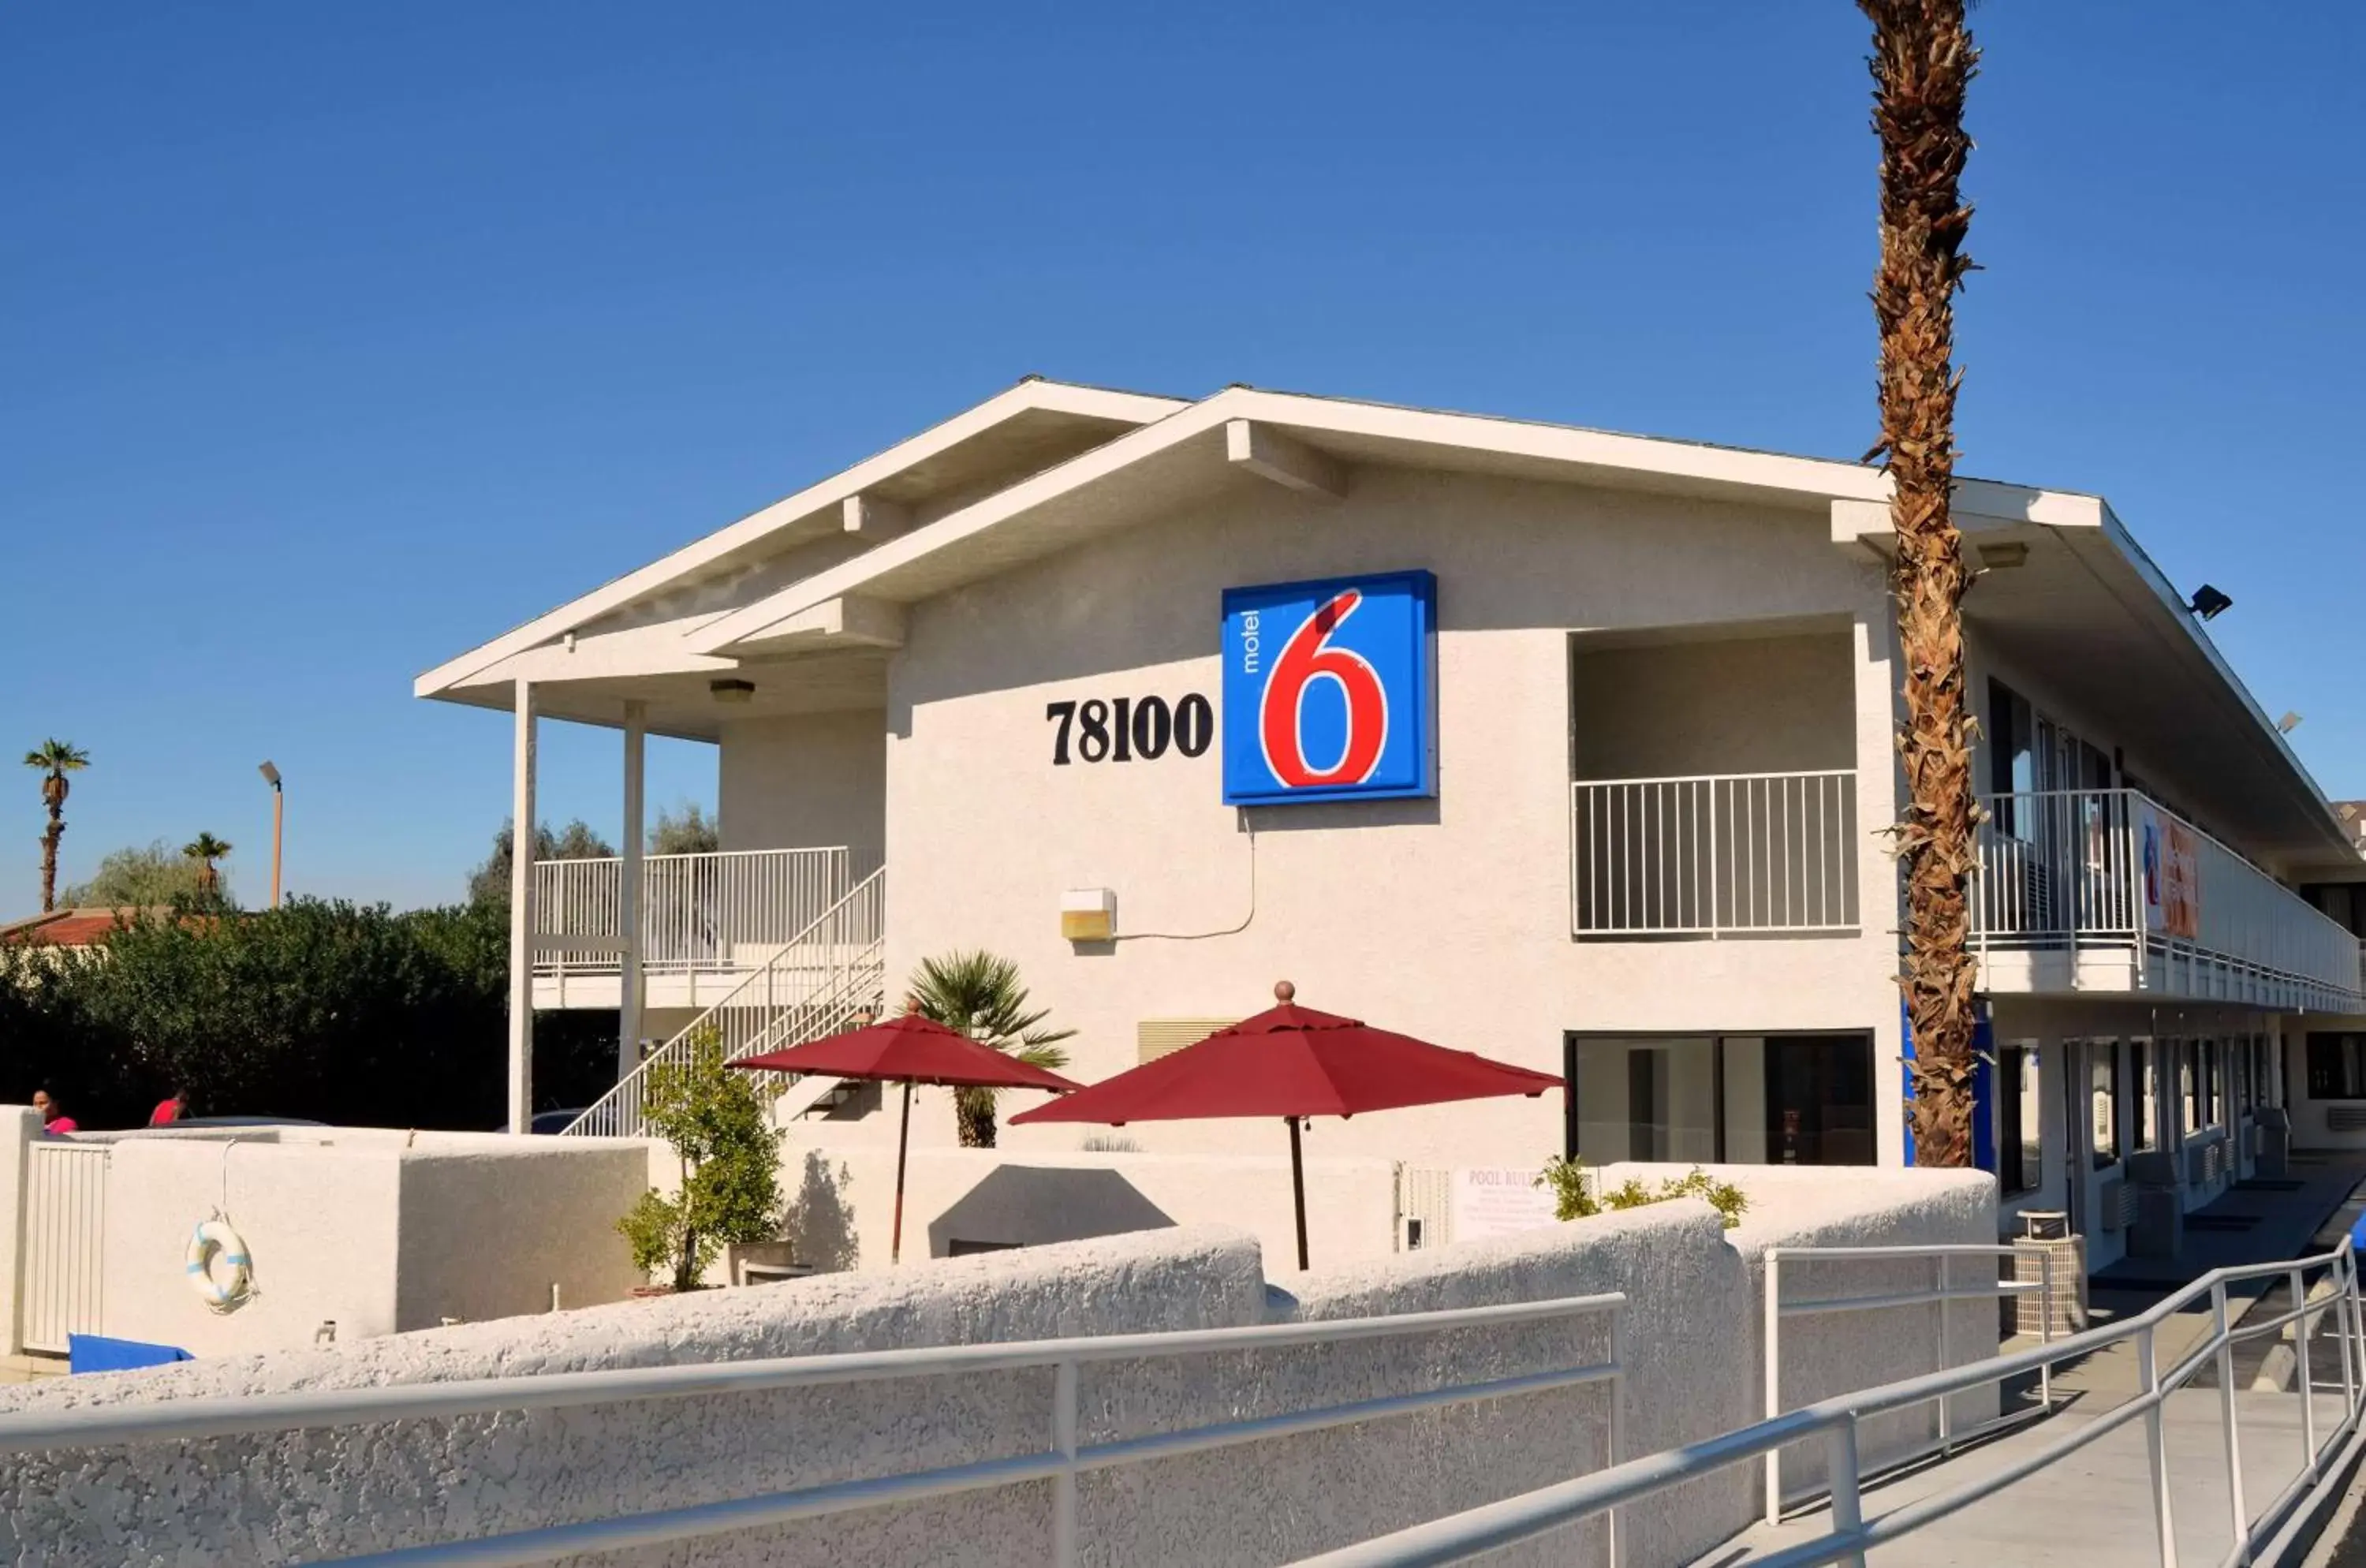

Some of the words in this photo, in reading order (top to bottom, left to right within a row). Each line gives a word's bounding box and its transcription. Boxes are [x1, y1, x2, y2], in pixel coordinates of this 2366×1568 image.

[1239, 610, 1260, 673] motel
[1259, 588, 1388, 788] 6
[1047, 693, 1214, 765] 78100
[1469, 1170, 1502, 1185] POOL
[1506, 1171, 1540, 1188] RULE
